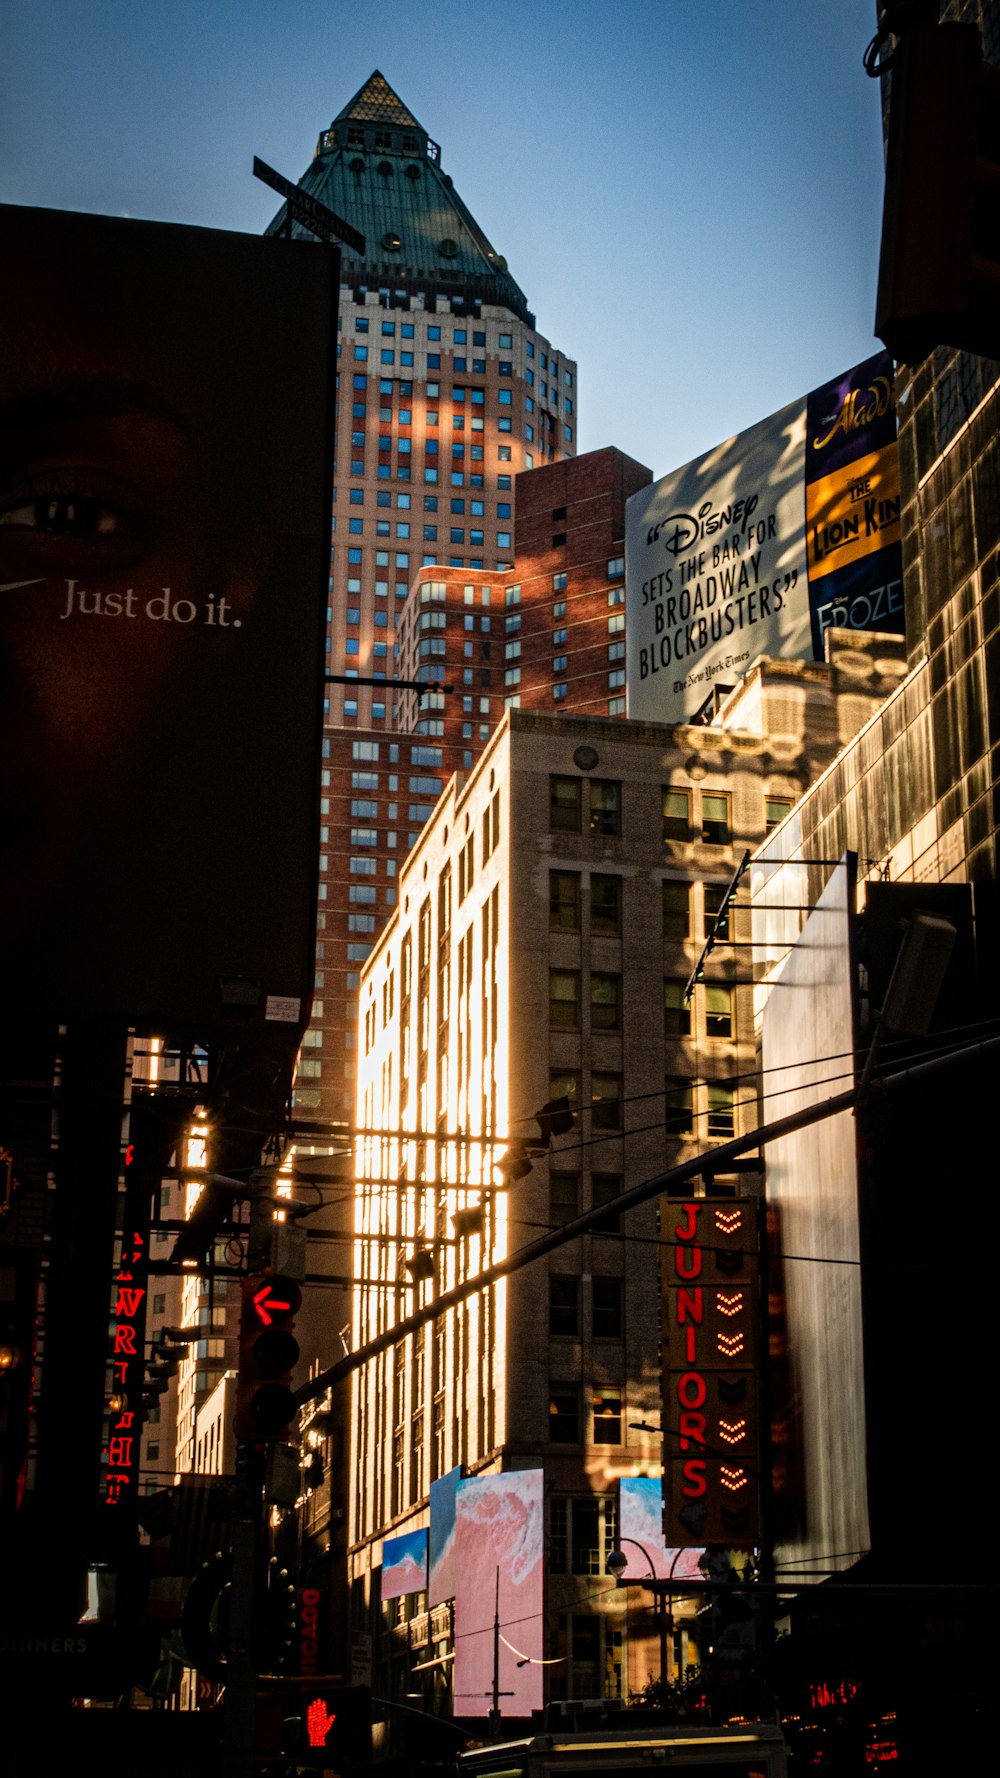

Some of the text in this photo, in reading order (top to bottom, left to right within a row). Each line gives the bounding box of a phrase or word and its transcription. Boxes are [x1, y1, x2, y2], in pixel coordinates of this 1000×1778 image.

[849, 480, 871, 500] THE
[642, 514, 776, 606] SETS THE BAR FOR
[814, 514, 858, 561] LION
[59, 579, 242, 627] Just do it.
[655, 551, 762, 635] BROADWAY
[673, 651, 750, 693] The New York Times
[675, 1203, 708, 1498] JUNIORS
